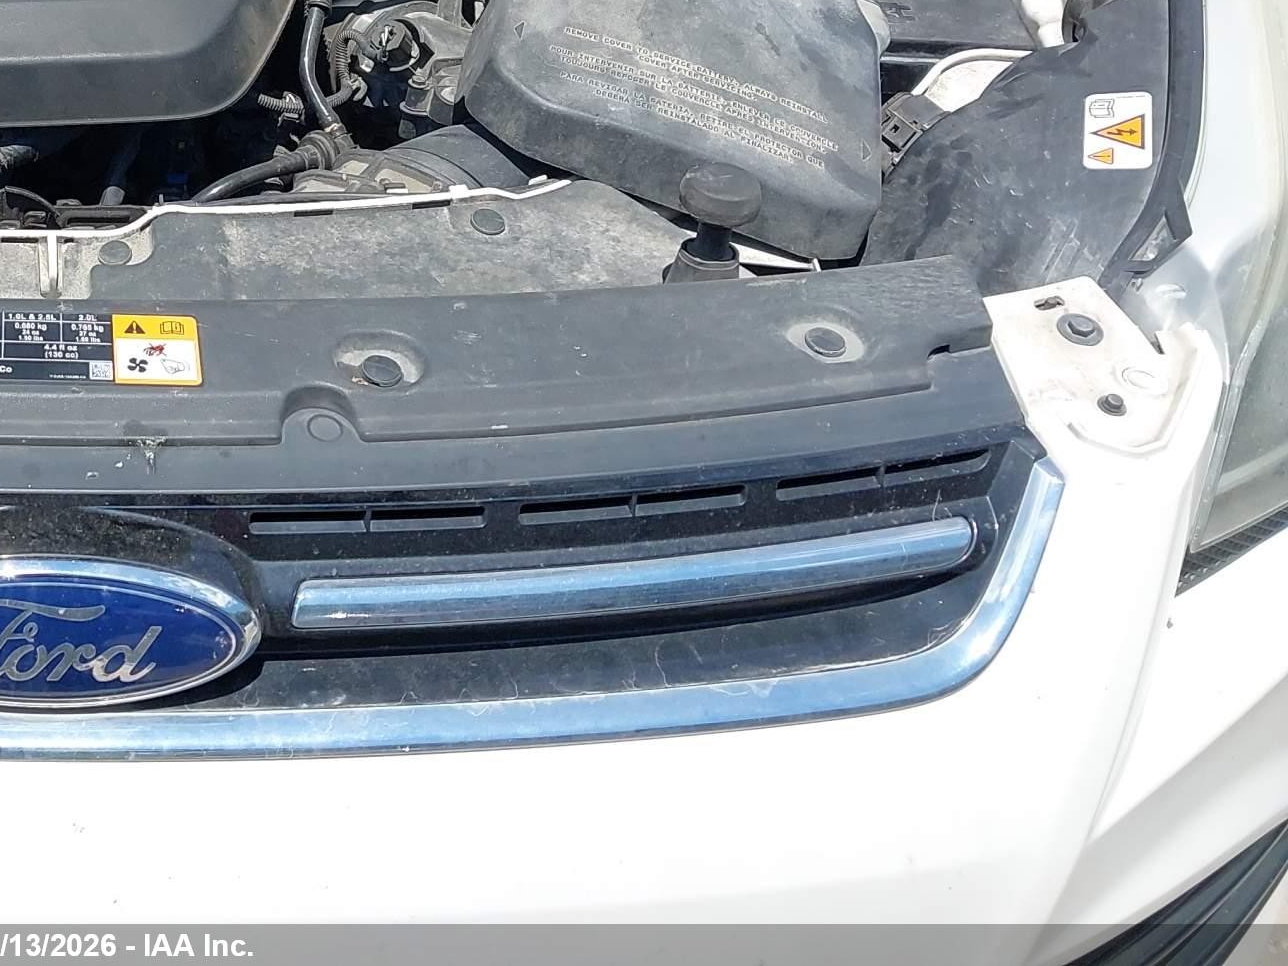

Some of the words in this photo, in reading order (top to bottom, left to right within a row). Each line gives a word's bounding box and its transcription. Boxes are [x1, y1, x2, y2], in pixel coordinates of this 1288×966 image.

[561, 56, 607, 73] TOUJOURS
[610, 69, 650, 86] REPOSER
[655, 83, 667, 93] LE
[671, 88, 723, 111] COUVERCLE
[564, 27, 599, 42] REMOVE
[603, 36, 632, 51] COVER
[637, 46, 650, 56] TO
[652, 51, 692, 69] SERVICE
[744, 83, 777, 102] ALWAYS
[780, 97, 829, 123] REINSTALL
[638, 55, 667, 69] COVER
[671, 66, 700, 80] AFTER
[550, 45, 573, 56] POUR
[578, 53, 634, 74] INTERVENIR
[639, 70, 657, 81] SUR
[661, 76, 673, 86] LA
[731, 101, 770, 121] ENLEVER
[773, 118, 786, 127] LE
[789, 124, 839, 151] COUVERCLE
[560, 71, 584, 83] PARA
[587, 79, 628, 95] REVISAR
[633, 91, 646, 101] LA
[700, 113, 733, 129] RETIRE
[738, 126, 749, 135] EL
[753, 134, 804, 159] PROTECTOR
[806, 155, 824, 168] QUE
[635, 101, 653, 111] SER
[657, 107, 720, 133] REINSTALADO
[723, 130, 735, 139] AL
[37, 323, 48, 331] kg
[93, 323, 105, 333] kg
[44, 351, 63, 359] (130
